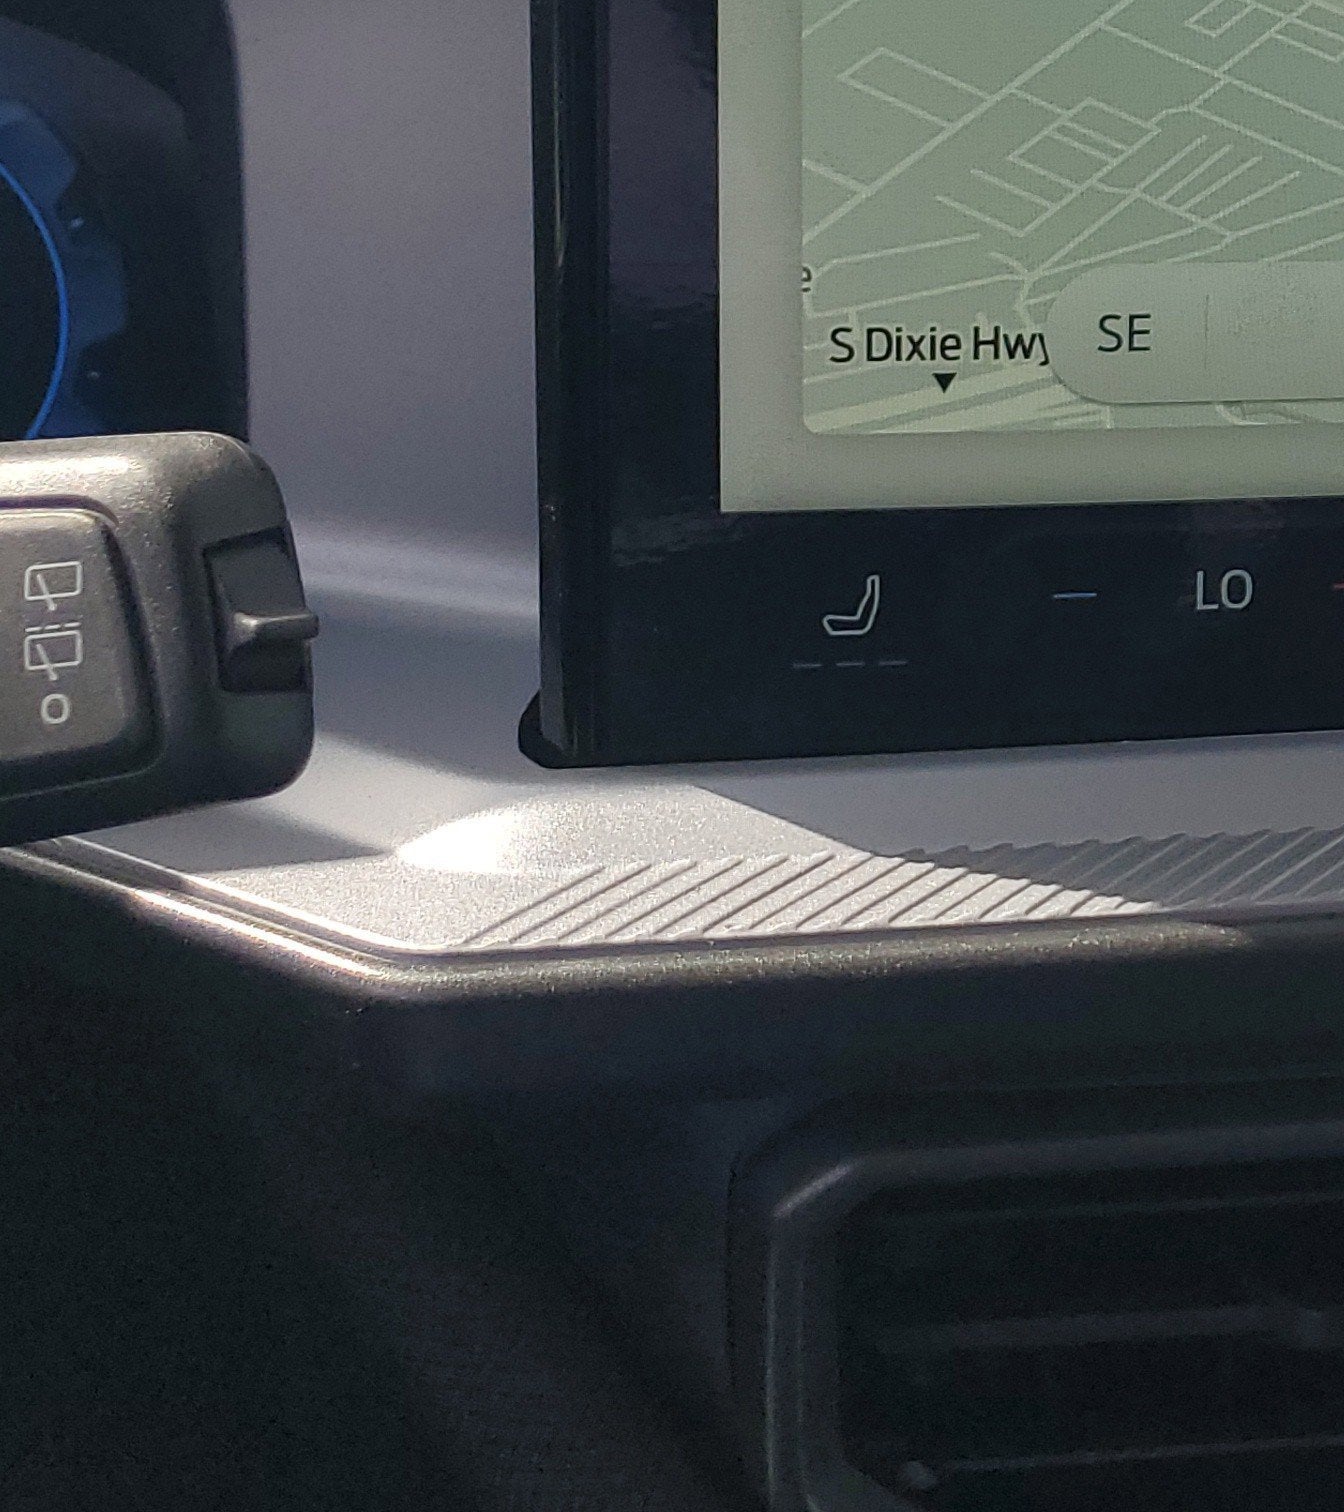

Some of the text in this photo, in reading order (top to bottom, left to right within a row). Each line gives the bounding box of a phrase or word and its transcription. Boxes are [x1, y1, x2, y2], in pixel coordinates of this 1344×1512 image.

[829, 326, 855, 363] S
[866, 325, 963, 362] Dixie
[1097, 314, 1152, 352] SE
[1197, 570, 1253, 610] LO
